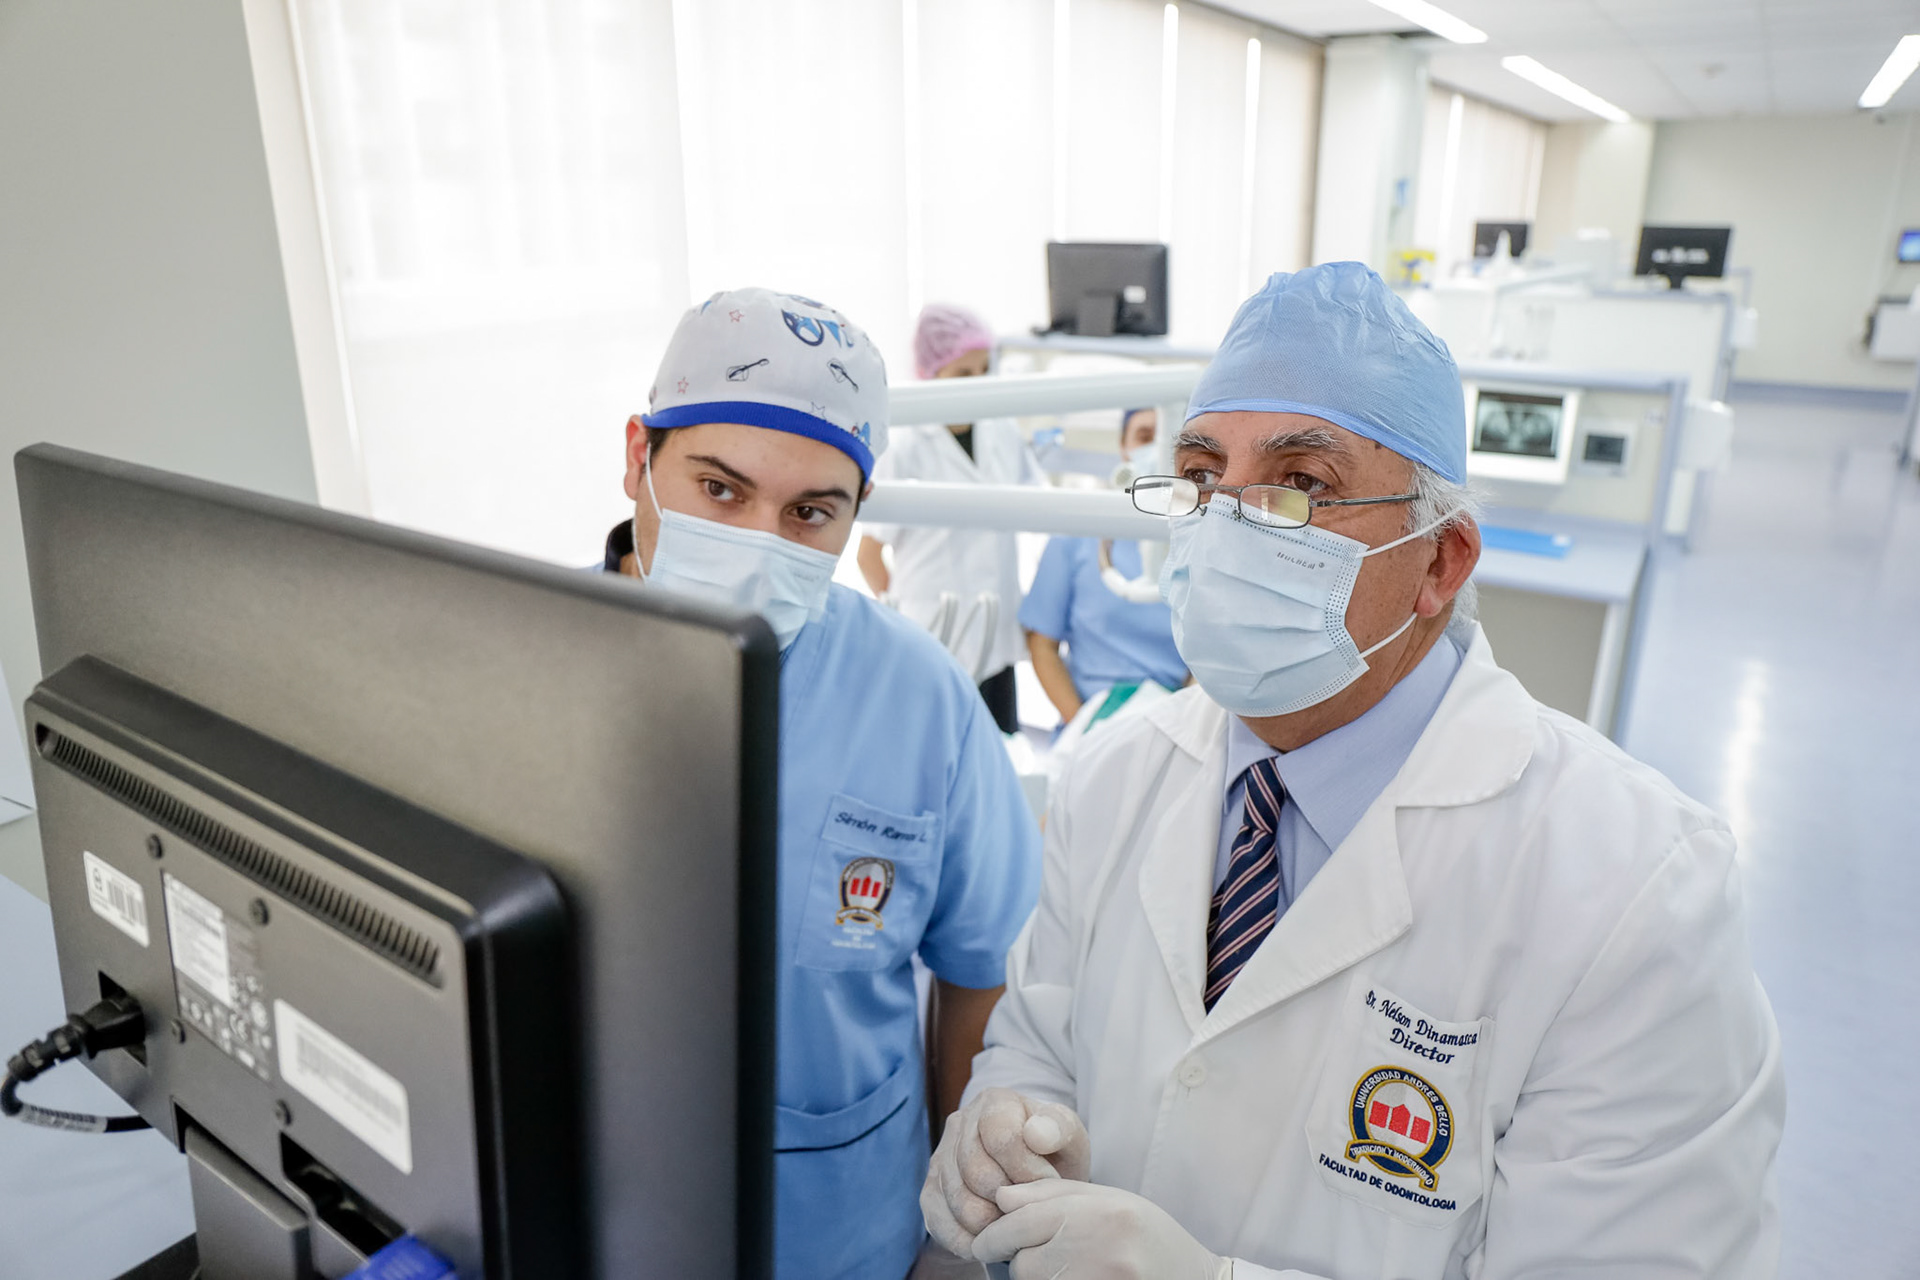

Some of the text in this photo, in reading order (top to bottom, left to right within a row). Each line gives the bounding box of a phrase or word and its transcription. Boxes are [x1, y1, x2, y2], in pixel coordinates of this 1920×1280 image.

[1365, 990, 1377, 1009] Dr.
[1379, 1000, 1411, 1028] Nelson
[1390, 1028, 1455, 1064] Director
[1354, 1071, 1450, 1137] UNIVERSIDAD ANDRES BELLO
[1319, 1153, 1456, 1210] FACULTAD DE ODONTOLOGIA
